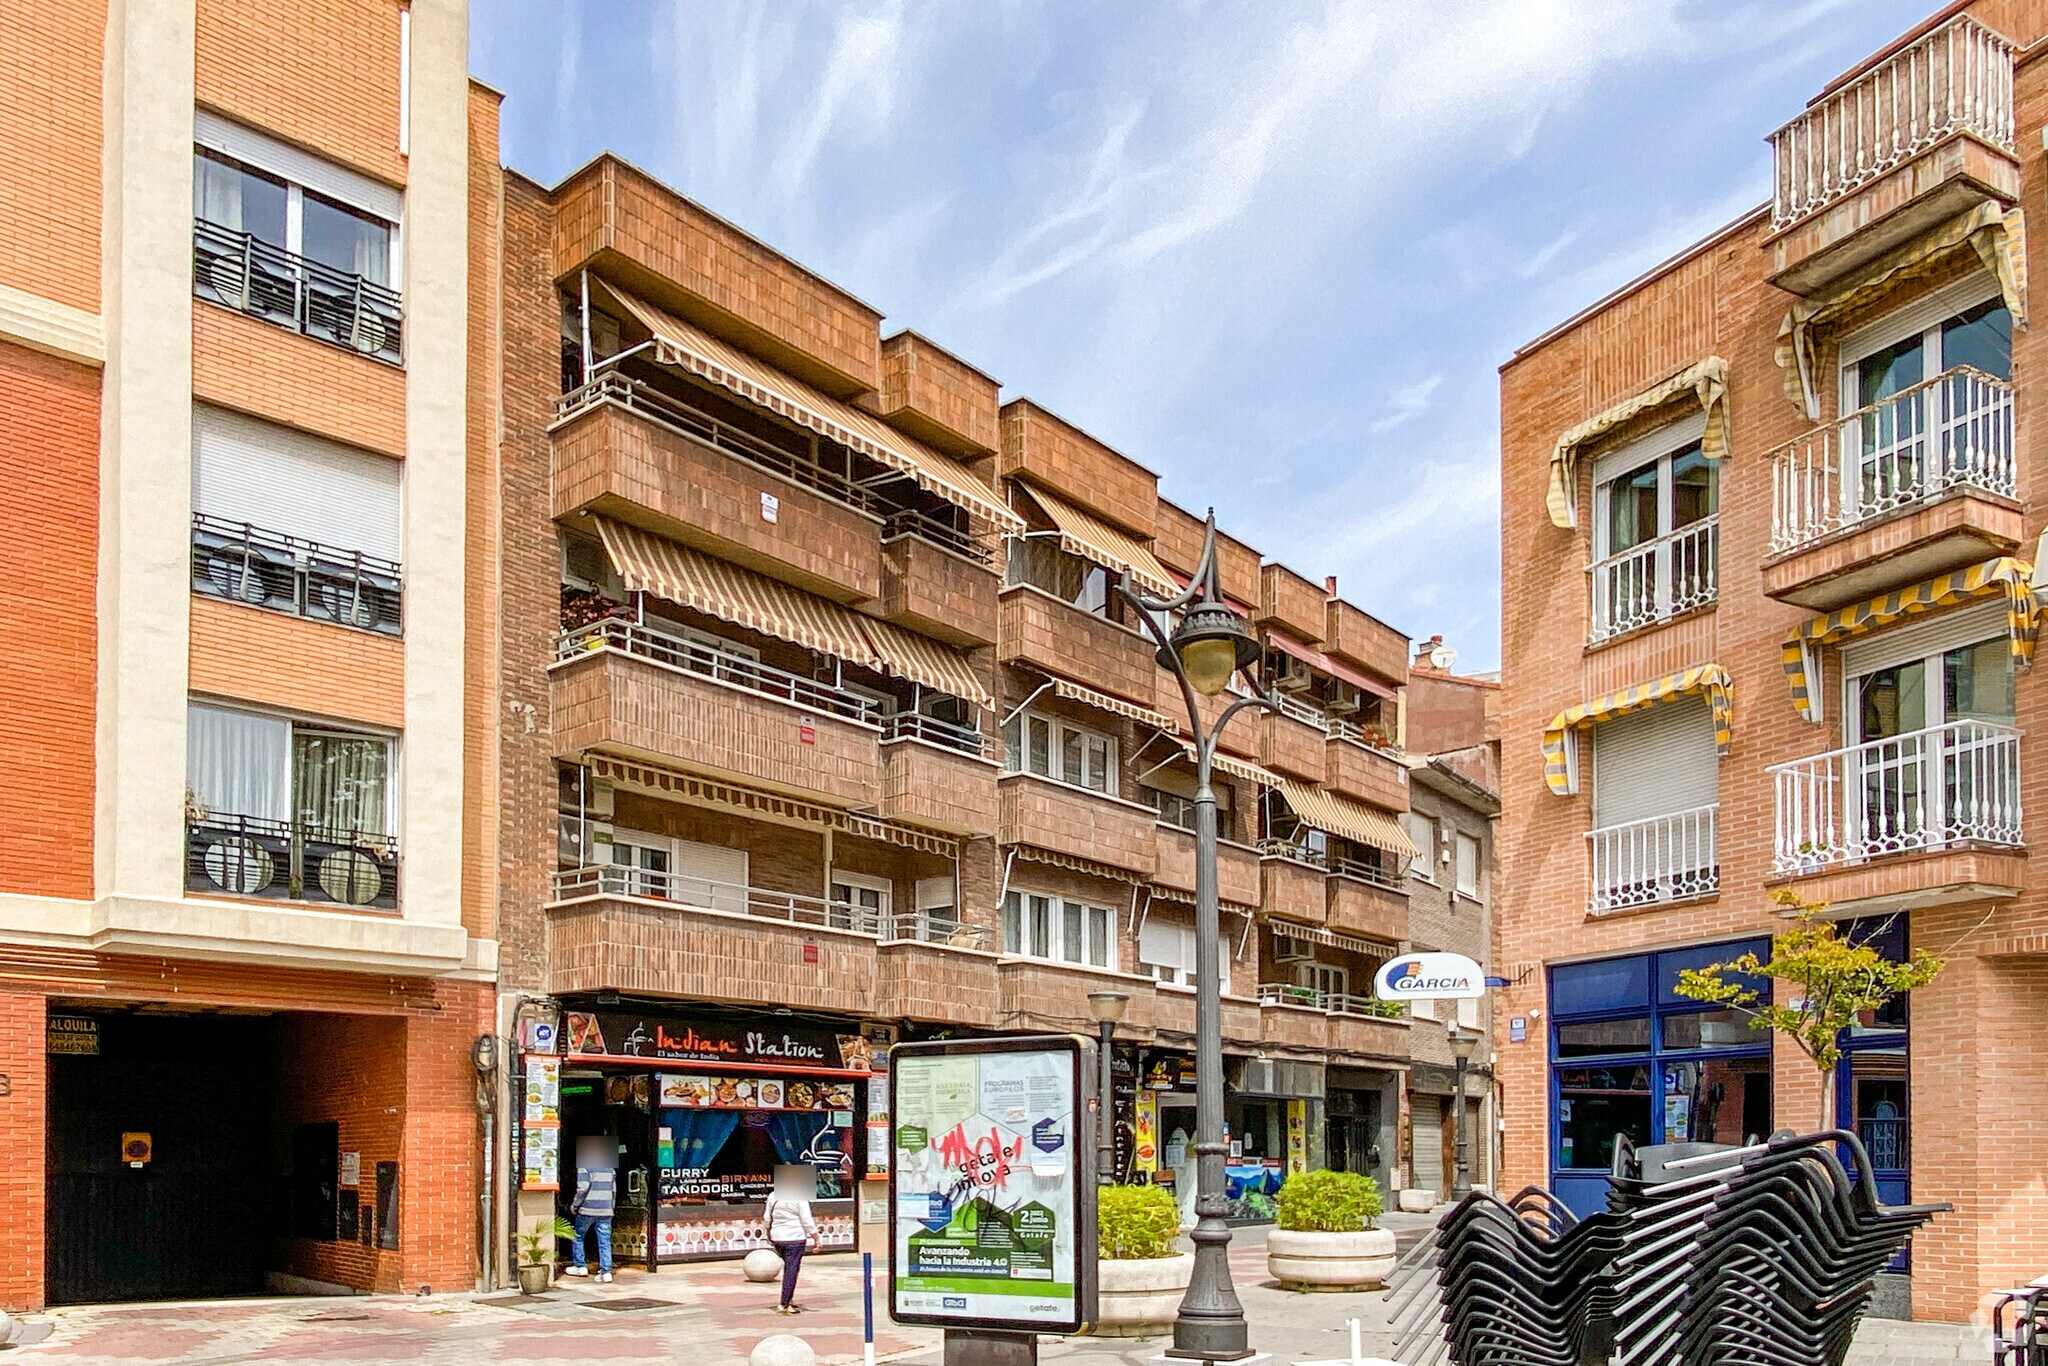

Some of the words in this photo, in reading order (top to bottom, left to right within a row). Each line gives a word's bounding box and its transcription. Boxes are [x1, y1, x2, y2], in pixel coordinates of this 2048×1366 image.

[1400, 978, 1468, 989] GARCIA
[50, 1019, 97, 1032] ALQUILA
[656, 1025, 737, 1053] Indian
[744, 1032, 824, 1059] Station
[661, 1168, 710, 1178] CURRY
[721, 1174, 772, 1183] BIRYANI
[662, 1184, 734, 1195] TANDOORI
[1020, 1210, 1029, 1222] 2
[919, 1246, 970, 1256] Avanzando
[919, 1256, 942, 1265] hacia
[943, 1257, 951, 1265] la
[953, 1257, 992, 1267] Industria
